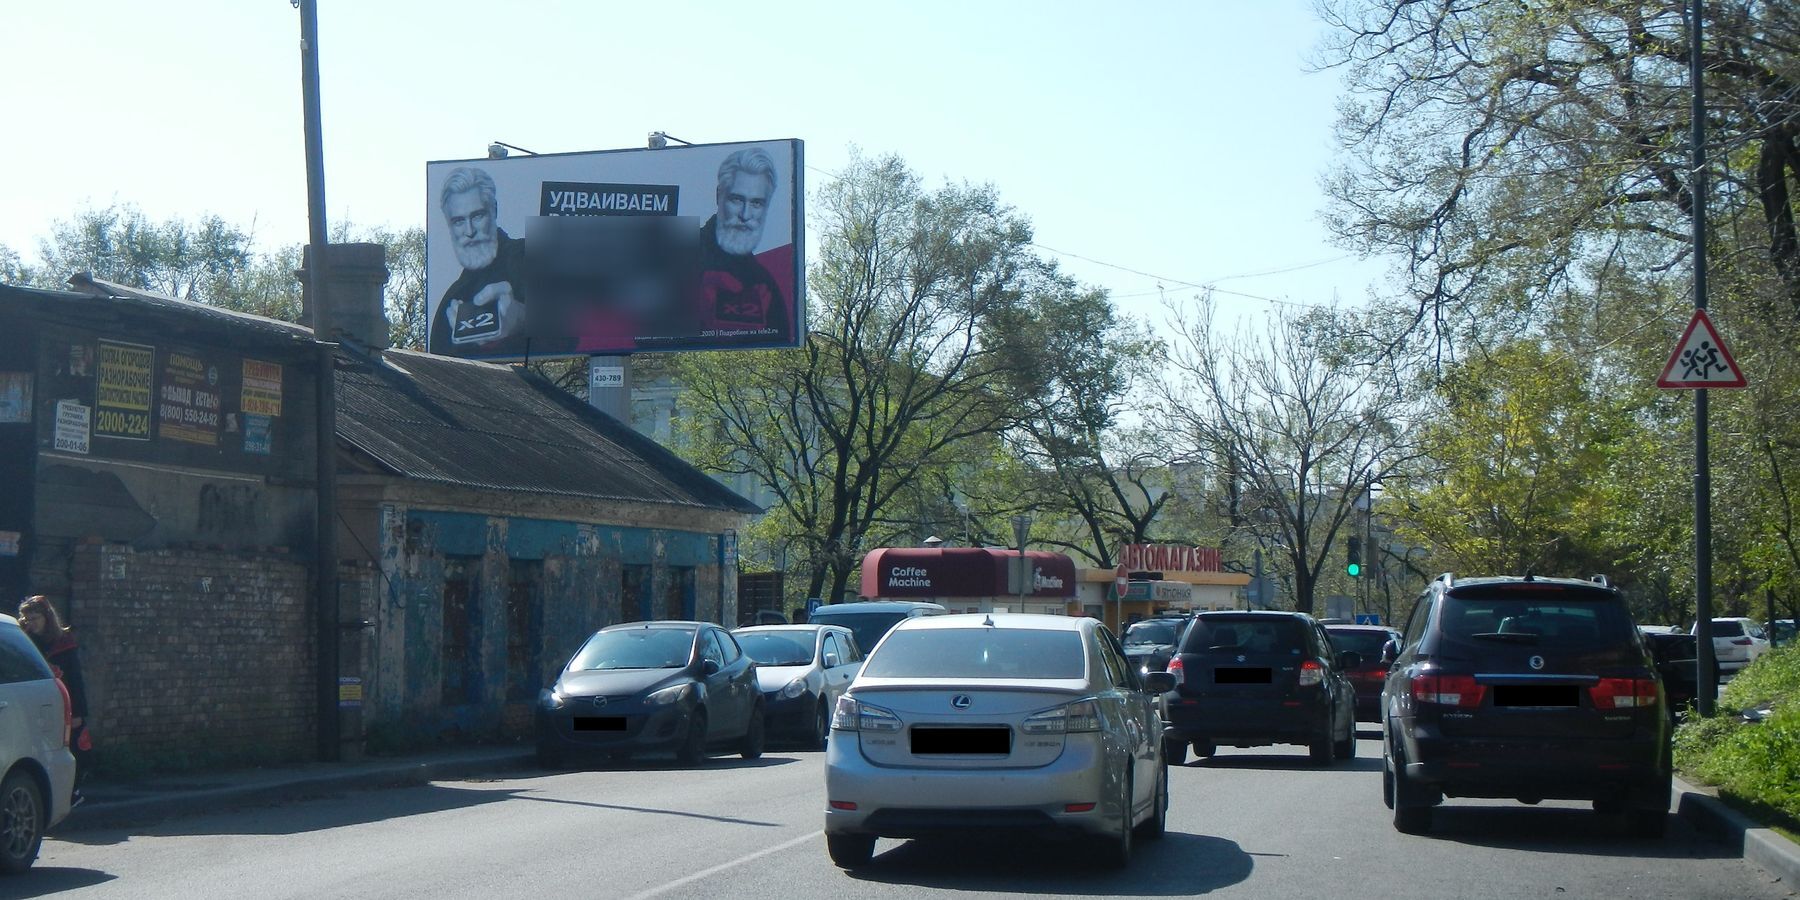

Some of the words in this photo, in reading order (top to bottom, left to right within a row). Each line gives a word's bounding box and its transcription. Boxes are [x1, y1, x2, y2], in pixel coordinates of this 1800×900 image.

[550, 191, 669, 212] УДВАИВАЕМ
[758, 327, 779, 335] tele2.ru
[595, 374, 622, 382] 430-789
[160, 404, 183, 423] 8(800)
[97, 410, 148, 434] 2000-224
[1119, 543, 1222, 572] АВТОМАГАЗИН
[892, 566, 927, 577] Coffee
[889, 577, 931, 587] Machine
